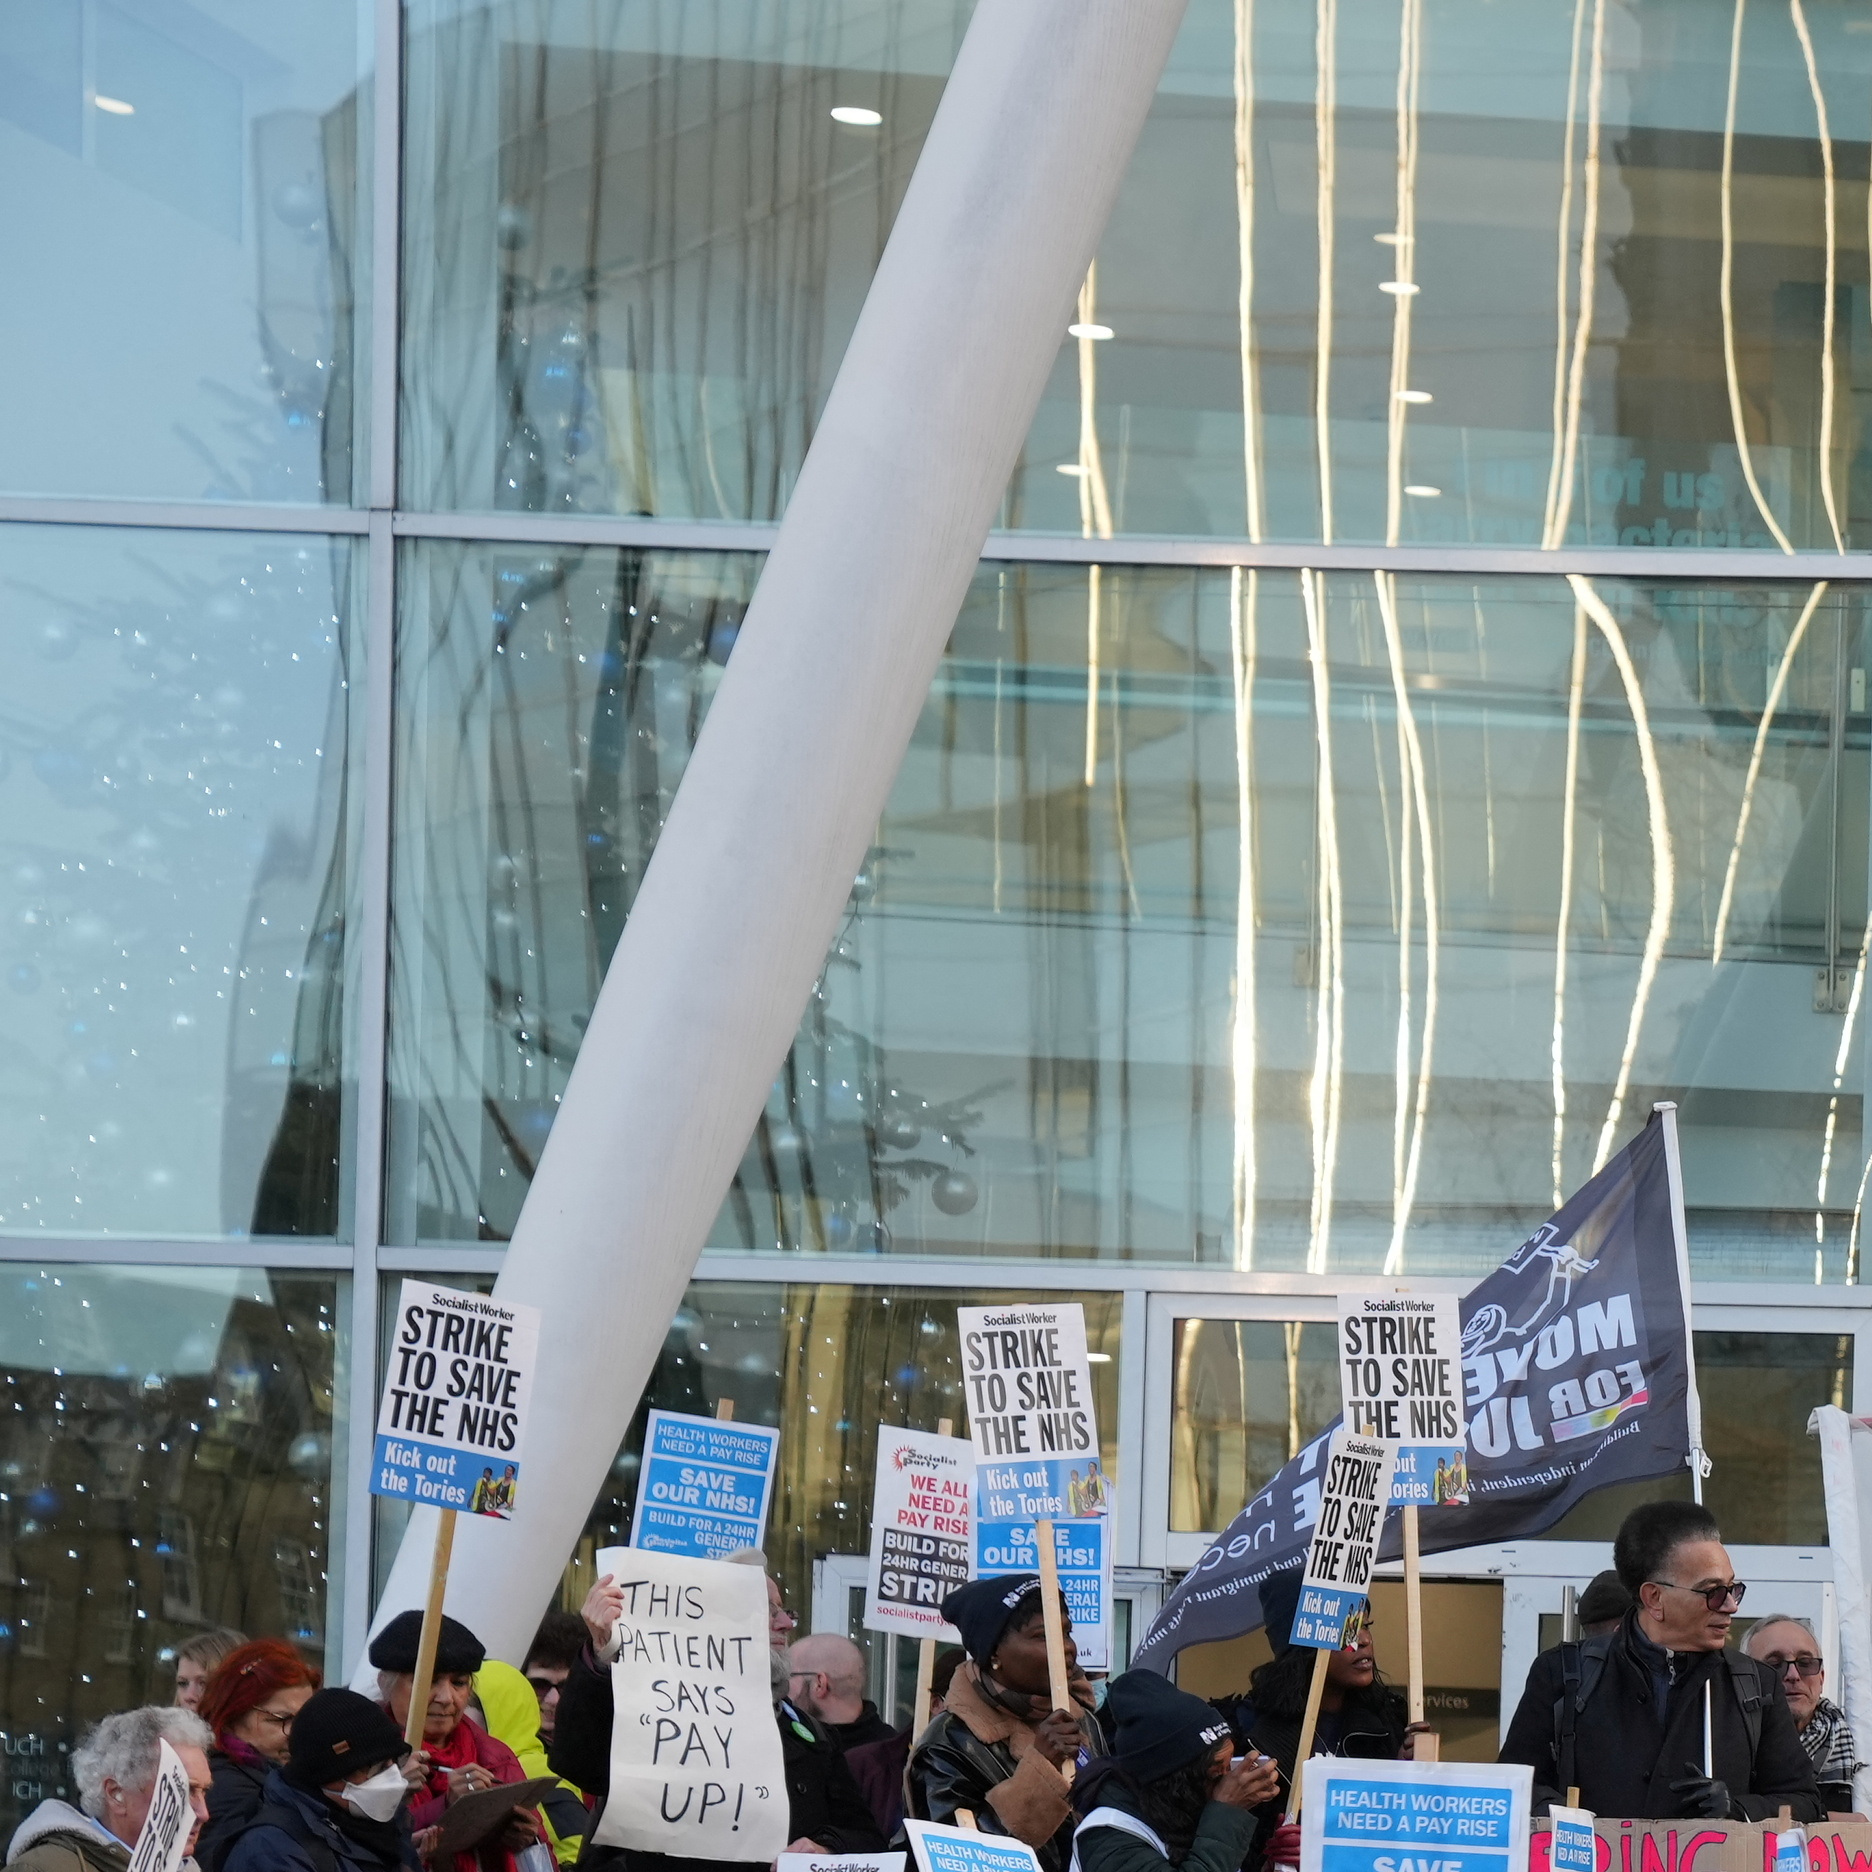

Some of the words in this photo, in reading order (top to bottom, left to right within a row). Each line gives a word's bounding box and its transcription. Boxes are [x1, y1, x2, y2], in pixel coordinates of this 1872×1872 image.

[402, 1305, 513, 1364] STRIKE
[966, 1328, 1062, 1372] STRIKE
[398, 1346, 436, 1390] TO
[446, 1358, 520, 1409] SAVE
[969, 1373, 1007, 1413] TO
[1016, 1370, 1081, 1411] SAVE
[390, 1388, 449, 1437] THE
[457, 1403, 518, 1452] NHS
[975, 1415, 1031, 1456] THE
[1039, 1411, 1090, 1453] NHS
[384, 1441, 420, 1469] Kick
[427, 1454, 456, 1476] out
[1328, 1455, 1382, 1500] STRIKE
[381, 1468, 408, 1493] the
[414, 1473, 466, 1504] Tories
[910, 1474, 937, 1492] WE
[897, 1509, 928, 1529] PAY
[908, 1493, 955, 1514] NEED
[1322, 1497, 1341, 1538] TO
[1343, 1501, 1380, 1543] SAVE
[882, 1553, 919, 1572] 24HR
[884, 1533, 936, 1556] BUILD
[1309, 1539, 1343, 1581] THE
[1343, 1546, 1373, 1586] NHS
[620, 1580, 704, 1619] THIS
[617, 1623, 752, 1675] PATIENT
[652, 1680, 734, 1716] SAYS
[1330, 1790, 1406, 1810] HEALTH
[1411, 1794, 1507, 1816] WORKERS
[1338, 1813, 1393, 1831] NEED
[1397, 1815, 1410, 1832] A
[1415, 1817, 1453, 1834] PAY
[1457, 1820, 1498, 1837] RISE
